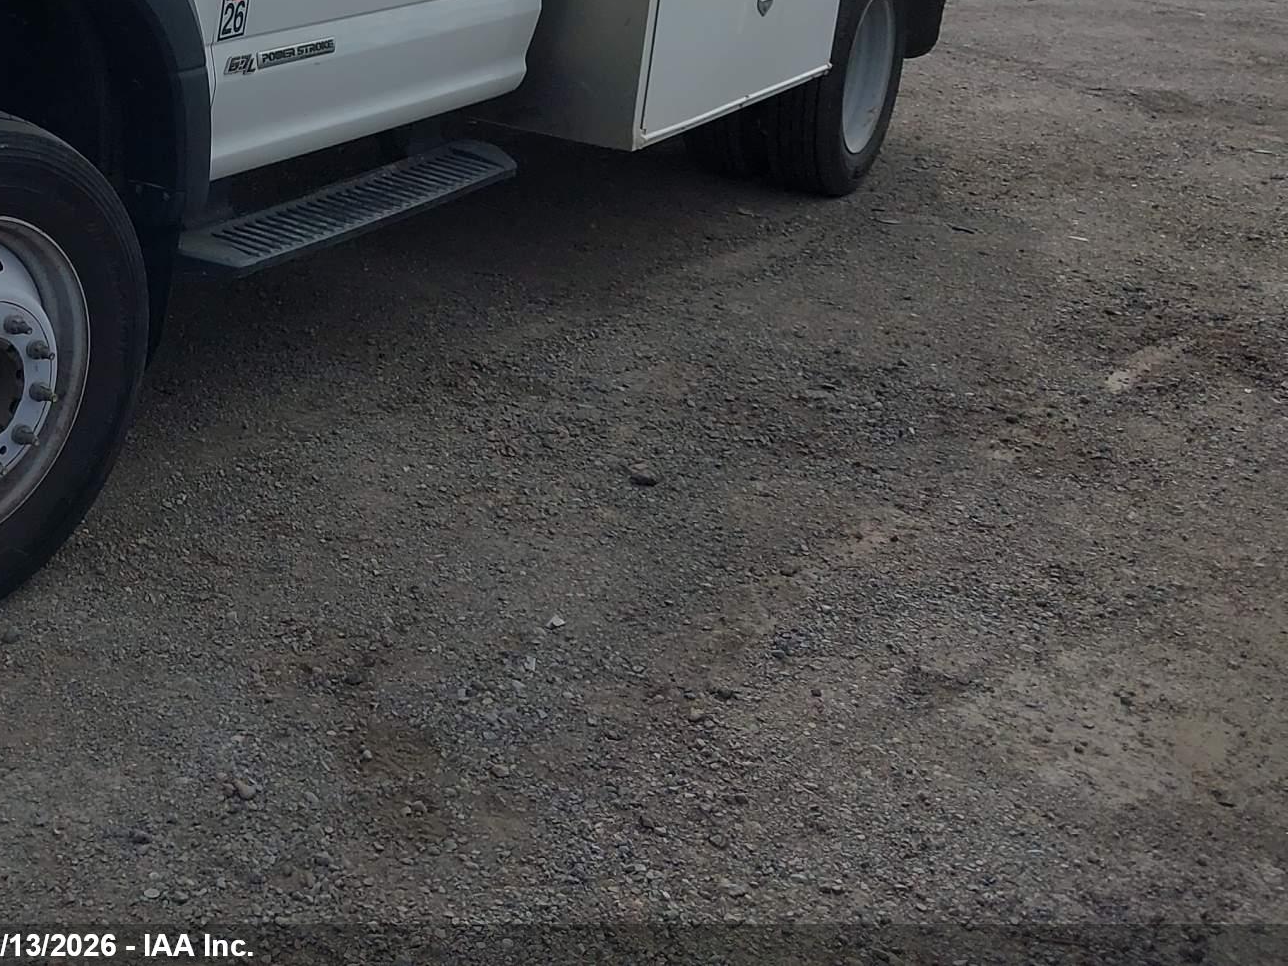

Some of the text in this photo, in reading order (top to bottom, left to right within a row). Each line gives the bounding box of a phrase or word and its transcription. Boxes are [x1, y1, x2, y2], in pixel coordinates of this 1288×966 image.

[221, 0, 246, 35] 26
[260, 39, 335, 64] POWER STROKE
